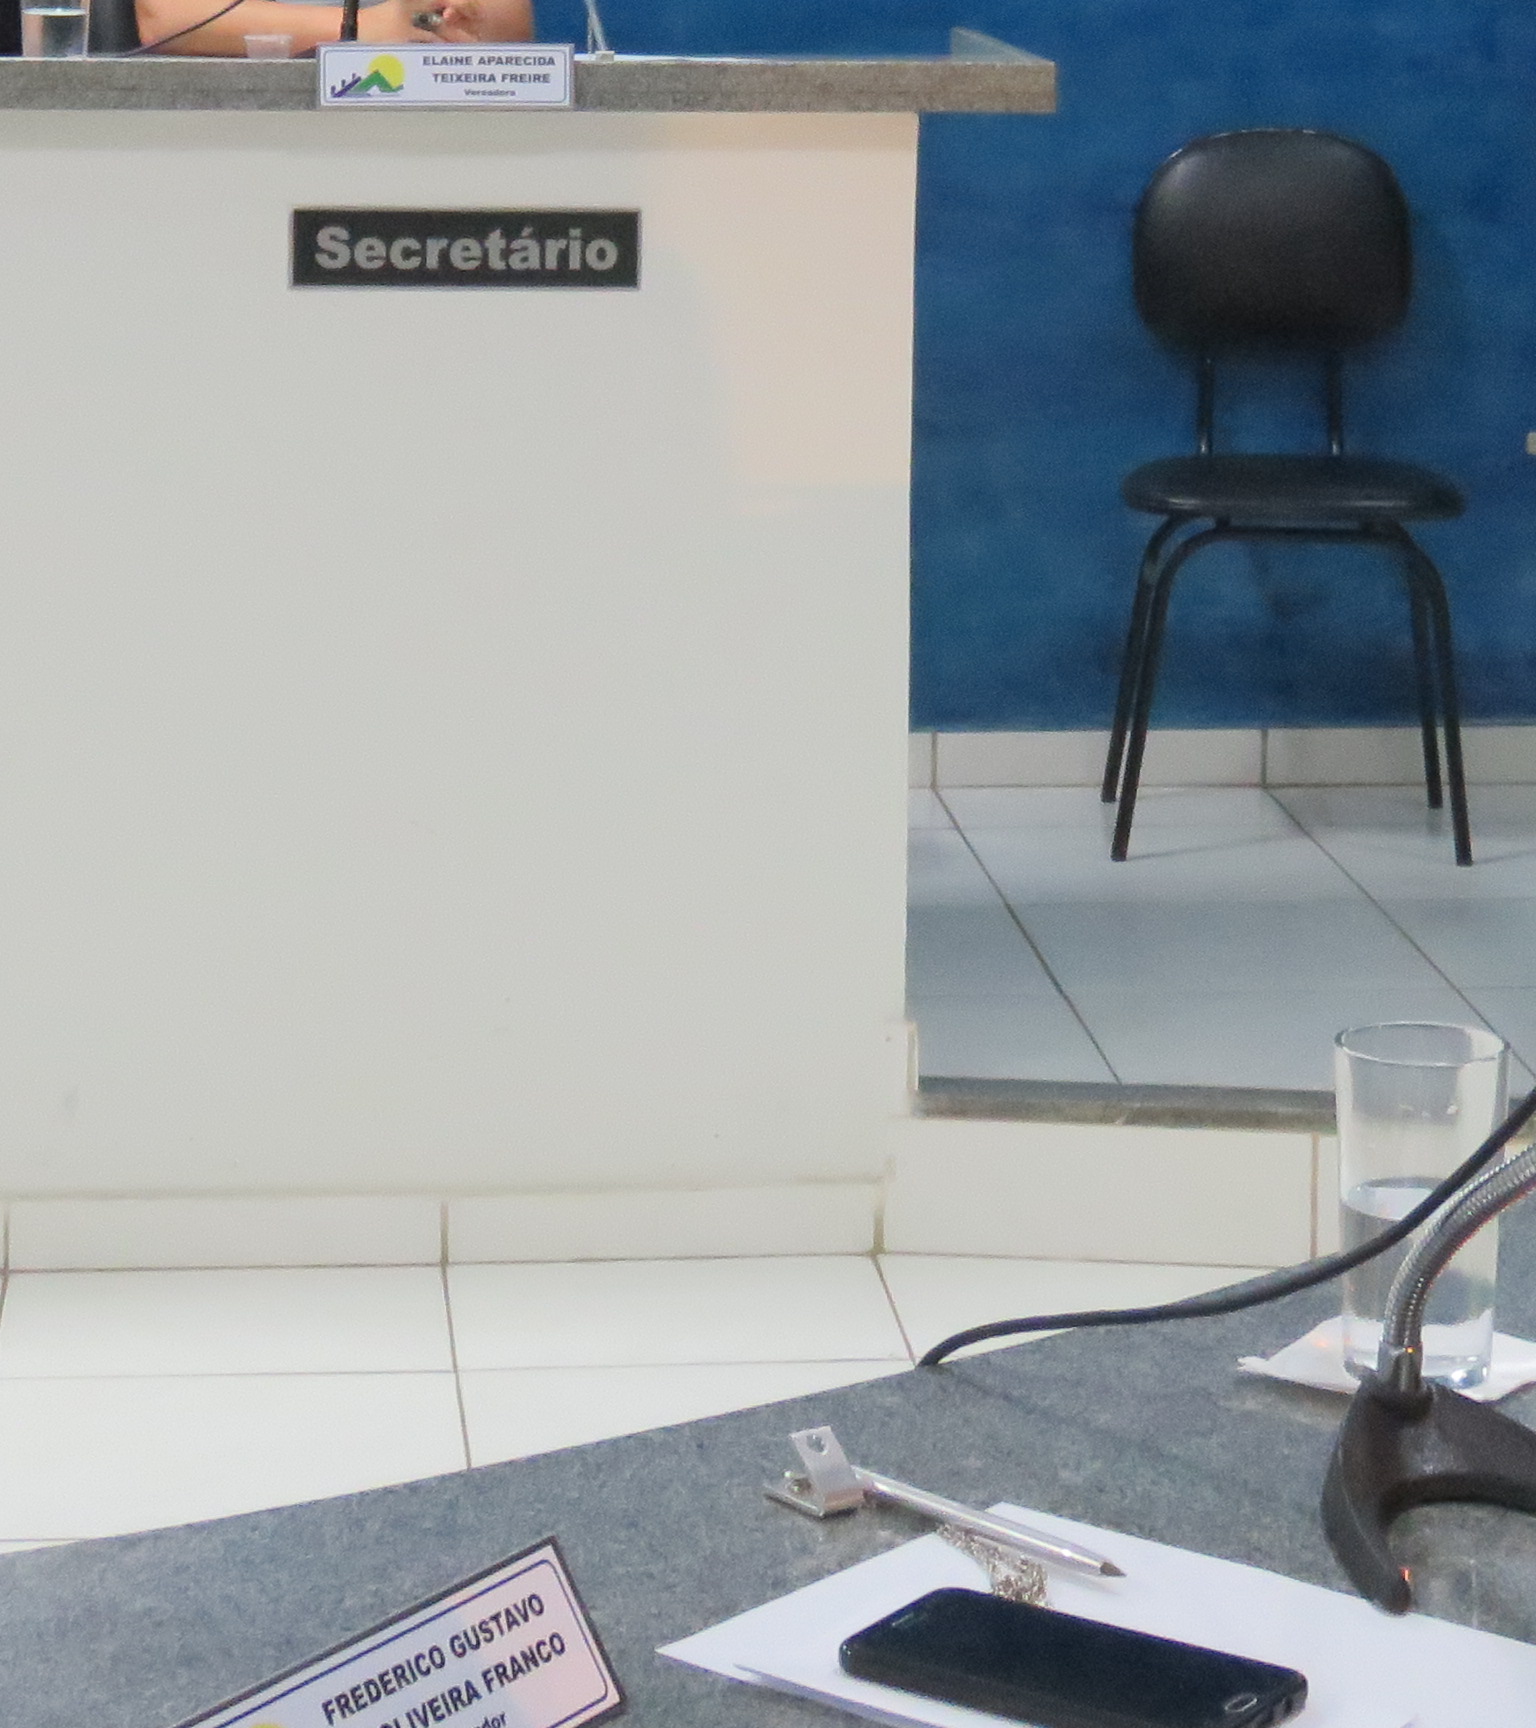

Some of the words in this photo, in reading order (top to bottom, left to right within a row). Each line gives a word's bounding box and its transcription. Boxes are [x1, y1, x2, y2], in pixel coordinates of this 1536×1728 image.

[422, 55, 474, 66] ELAINE
[477, 56, 556, 66] APARECIDA
[433, 73, 496, 83] TEIXEIRA
[500, 73, 551, 83] FREIRE
[314, 225, 618, 270] Secretário
[321, 1645, 447, 1726] FREDERICO
[448, 1593, 545, 1658] GUSTAVO
[380, 1679, 482, 1728] IVEIRA
[480, 1632, 566, 1694] FRANCO
